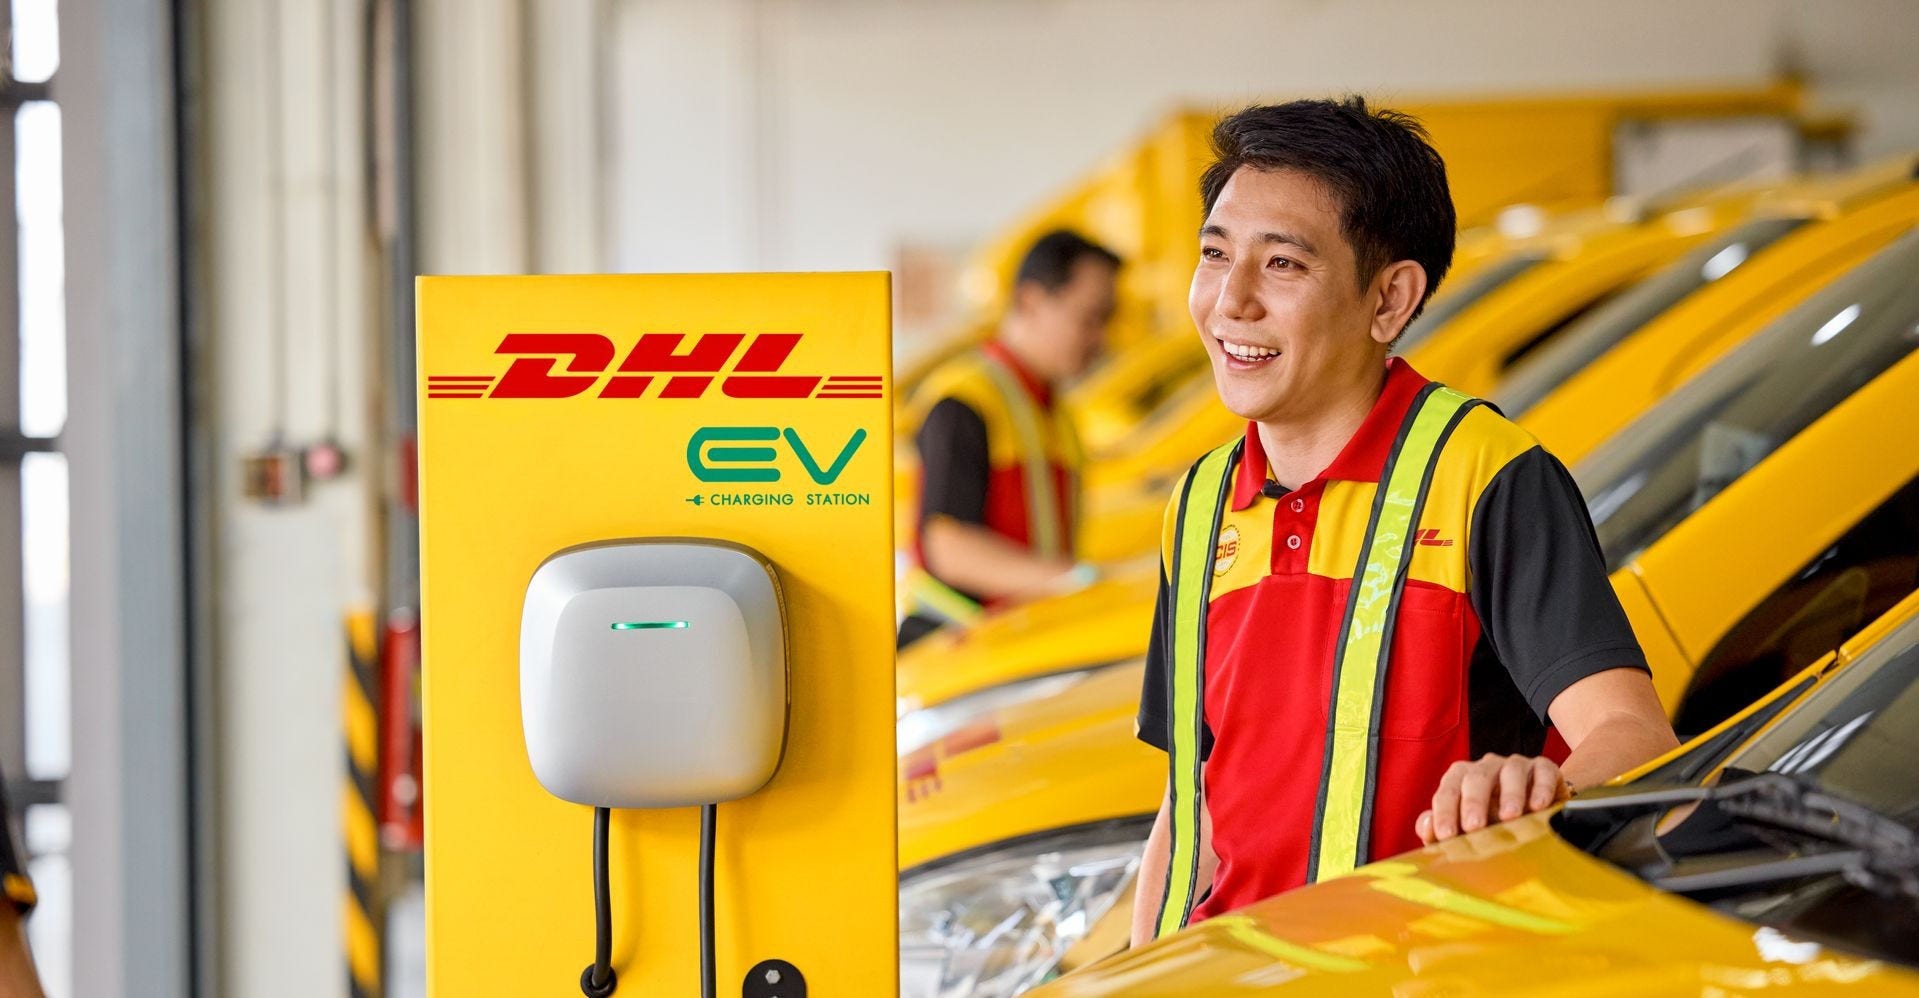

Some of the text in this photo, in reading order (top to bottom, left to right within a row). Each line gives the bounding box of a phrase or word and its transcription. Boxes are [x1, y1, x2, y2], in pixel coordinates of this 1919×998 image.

[487, 333, 824, 399] DHL
[686, 426, 867, 485] EV
[710, 493, 870, 506] CHARGING STATION
